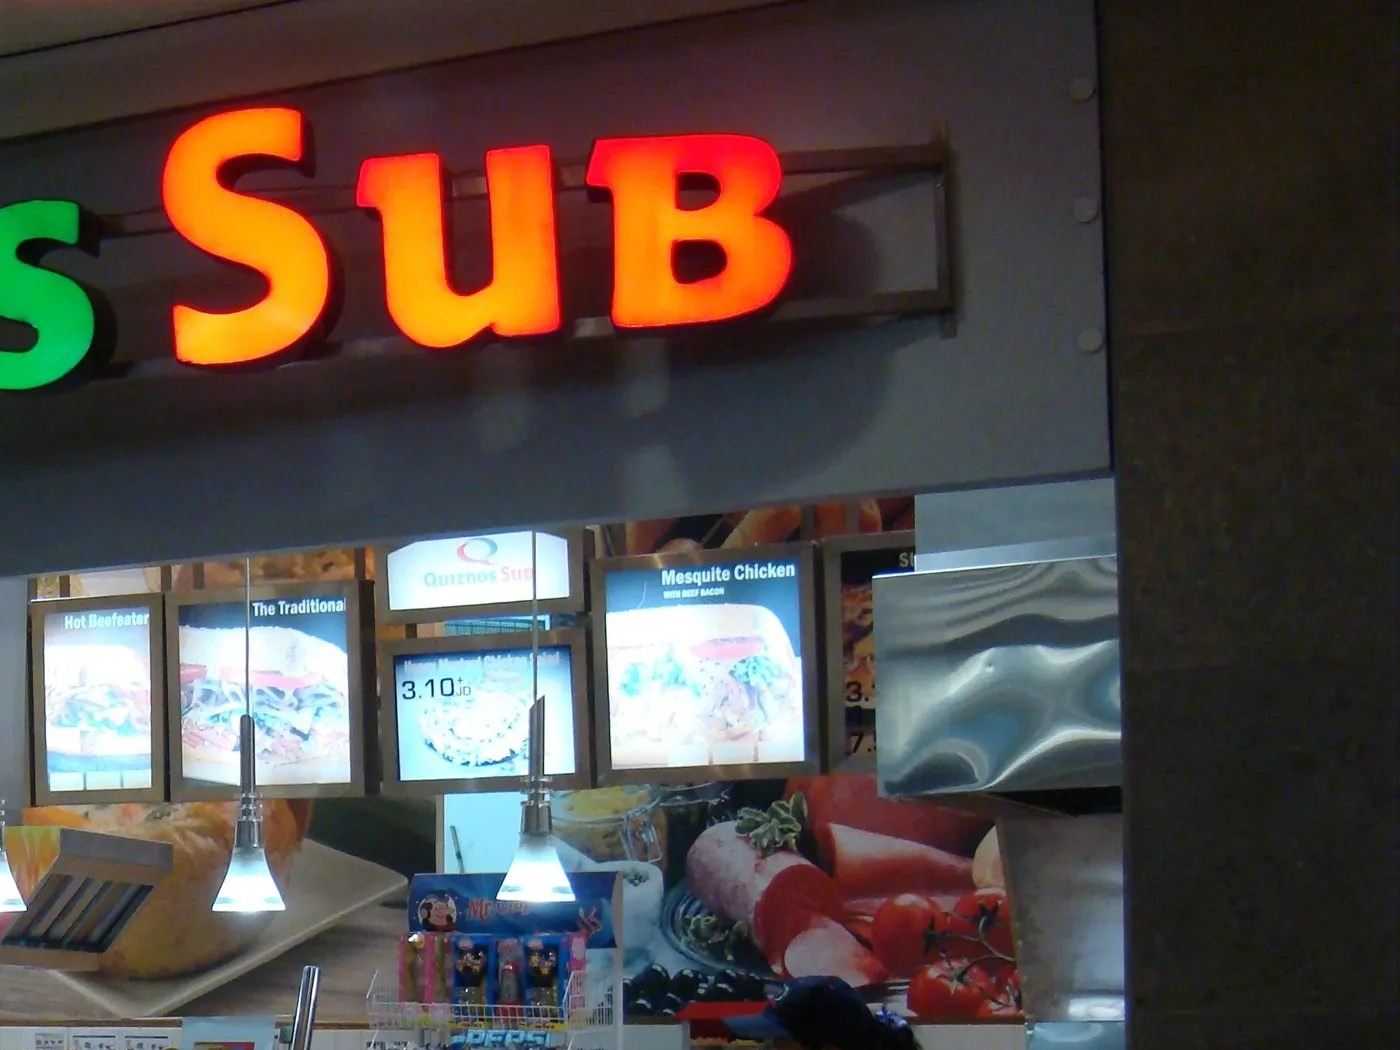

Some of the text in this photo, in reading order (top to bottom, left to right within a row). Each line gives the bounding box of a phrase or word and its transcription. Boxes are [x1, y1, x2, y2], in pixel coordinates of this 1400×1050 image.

[661, 563, 796, 587] Mesquite Chicken
[252, 597, 347, 617] The Traditional
[64, 611, 150, 631] Hot Beefeater
[401, 677, 455, 701] 3.10
